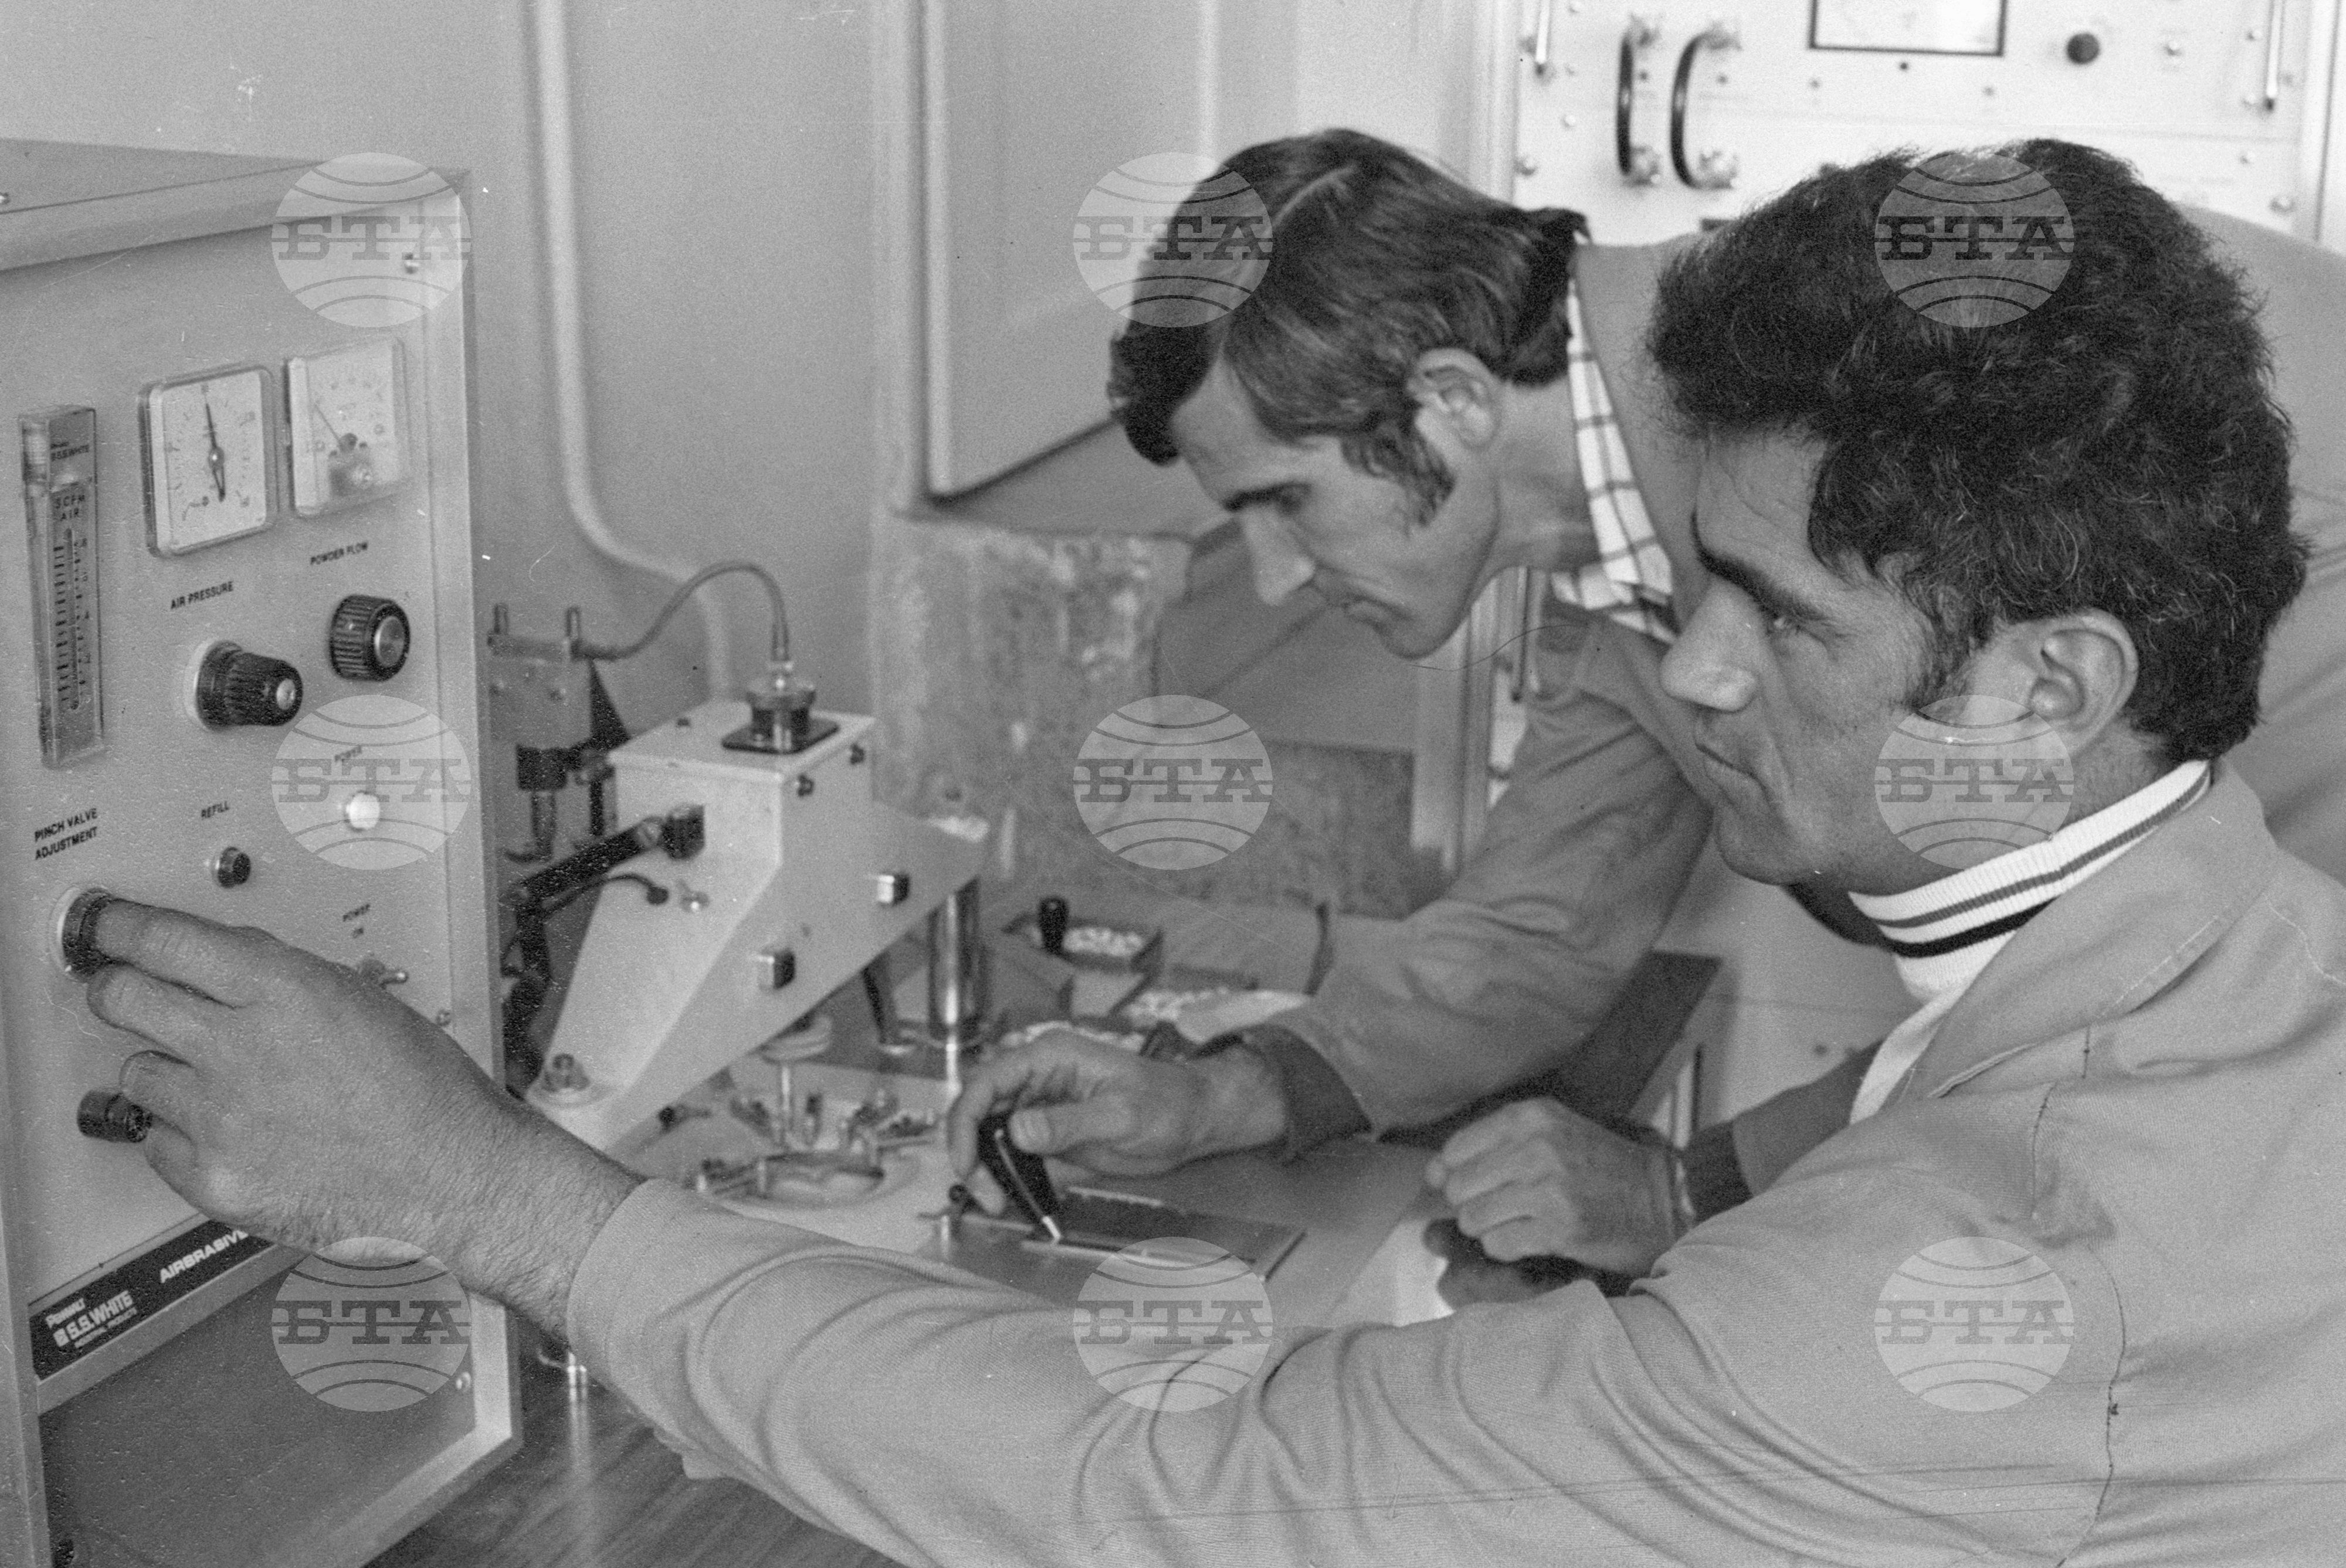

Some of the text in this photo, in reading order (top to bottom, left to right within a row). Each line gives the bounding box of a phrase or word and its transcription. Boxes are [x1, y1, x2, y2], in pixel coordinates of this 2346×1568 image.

[60, 507, 79, 521] AIR
[171, 581, 234, 609] AIR PRESSURE
[35, 808, 97, 842] PINCH VALVE
[35, 826, 97, 860] ADJUSTMENT
